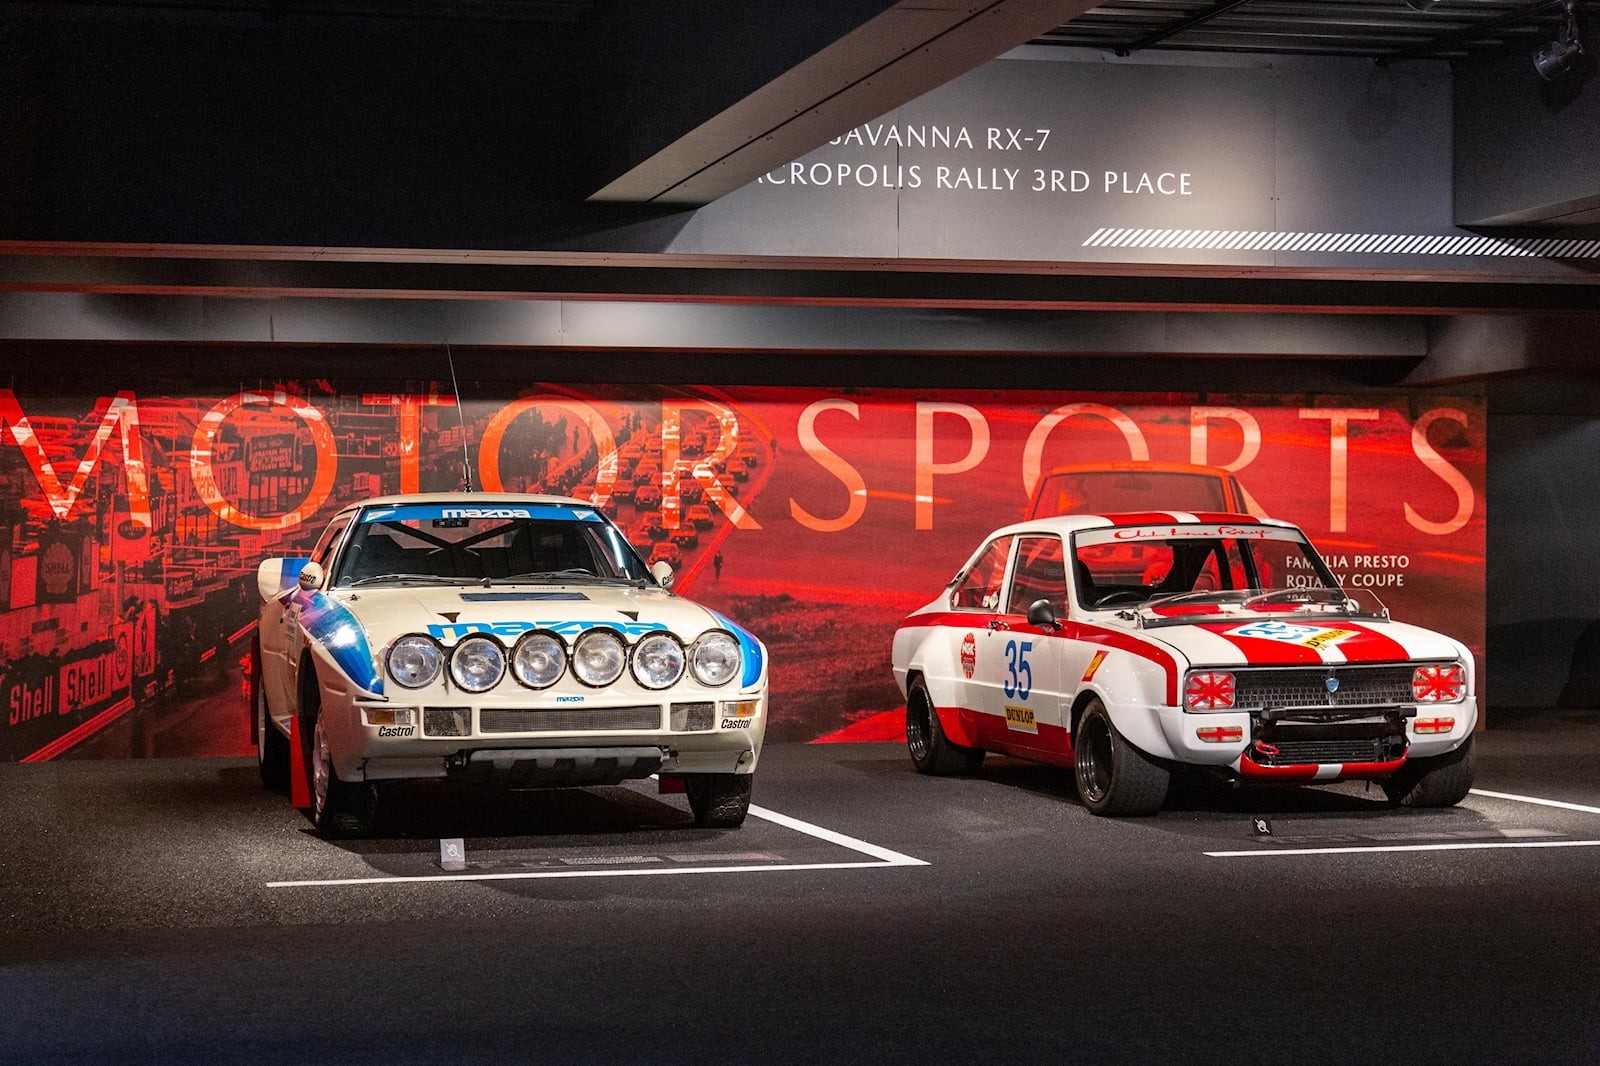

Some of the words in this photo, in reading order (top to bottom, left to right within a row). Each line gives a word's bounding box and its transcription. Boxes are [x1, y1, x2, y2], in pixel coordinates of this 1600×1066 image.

[987, 128, 1052, 152] RX-7
[758, 162, 922, 189] CROPOLIS
[936, 166, 1020, 191] RALLY
[1032, 167, 1090, 193] 3RD
[1104, 172, 1193, 195] PLACE
[441, 509, 531, 519] mazda
[1286, 555, 1348, 569] FAMLIA
[1355, 555, 1410, 568] PRESTO
[1286, 574, 1346, 588] ROTAY
[1351, 574, 1404, 587] COUPE
[1238, 623, 1319, 640] 35
[961, 641, 975, 656] NGK
[1004, 640, 1033, 701] 35
[67, 660, 105, 707] Shell
[9, 675, 53, 726] Shell
[721, 718, 752, 729] Castrol
[1006, 708, 1035, 724] DUNLOP
[379, 726, 415, 737] Castrol
